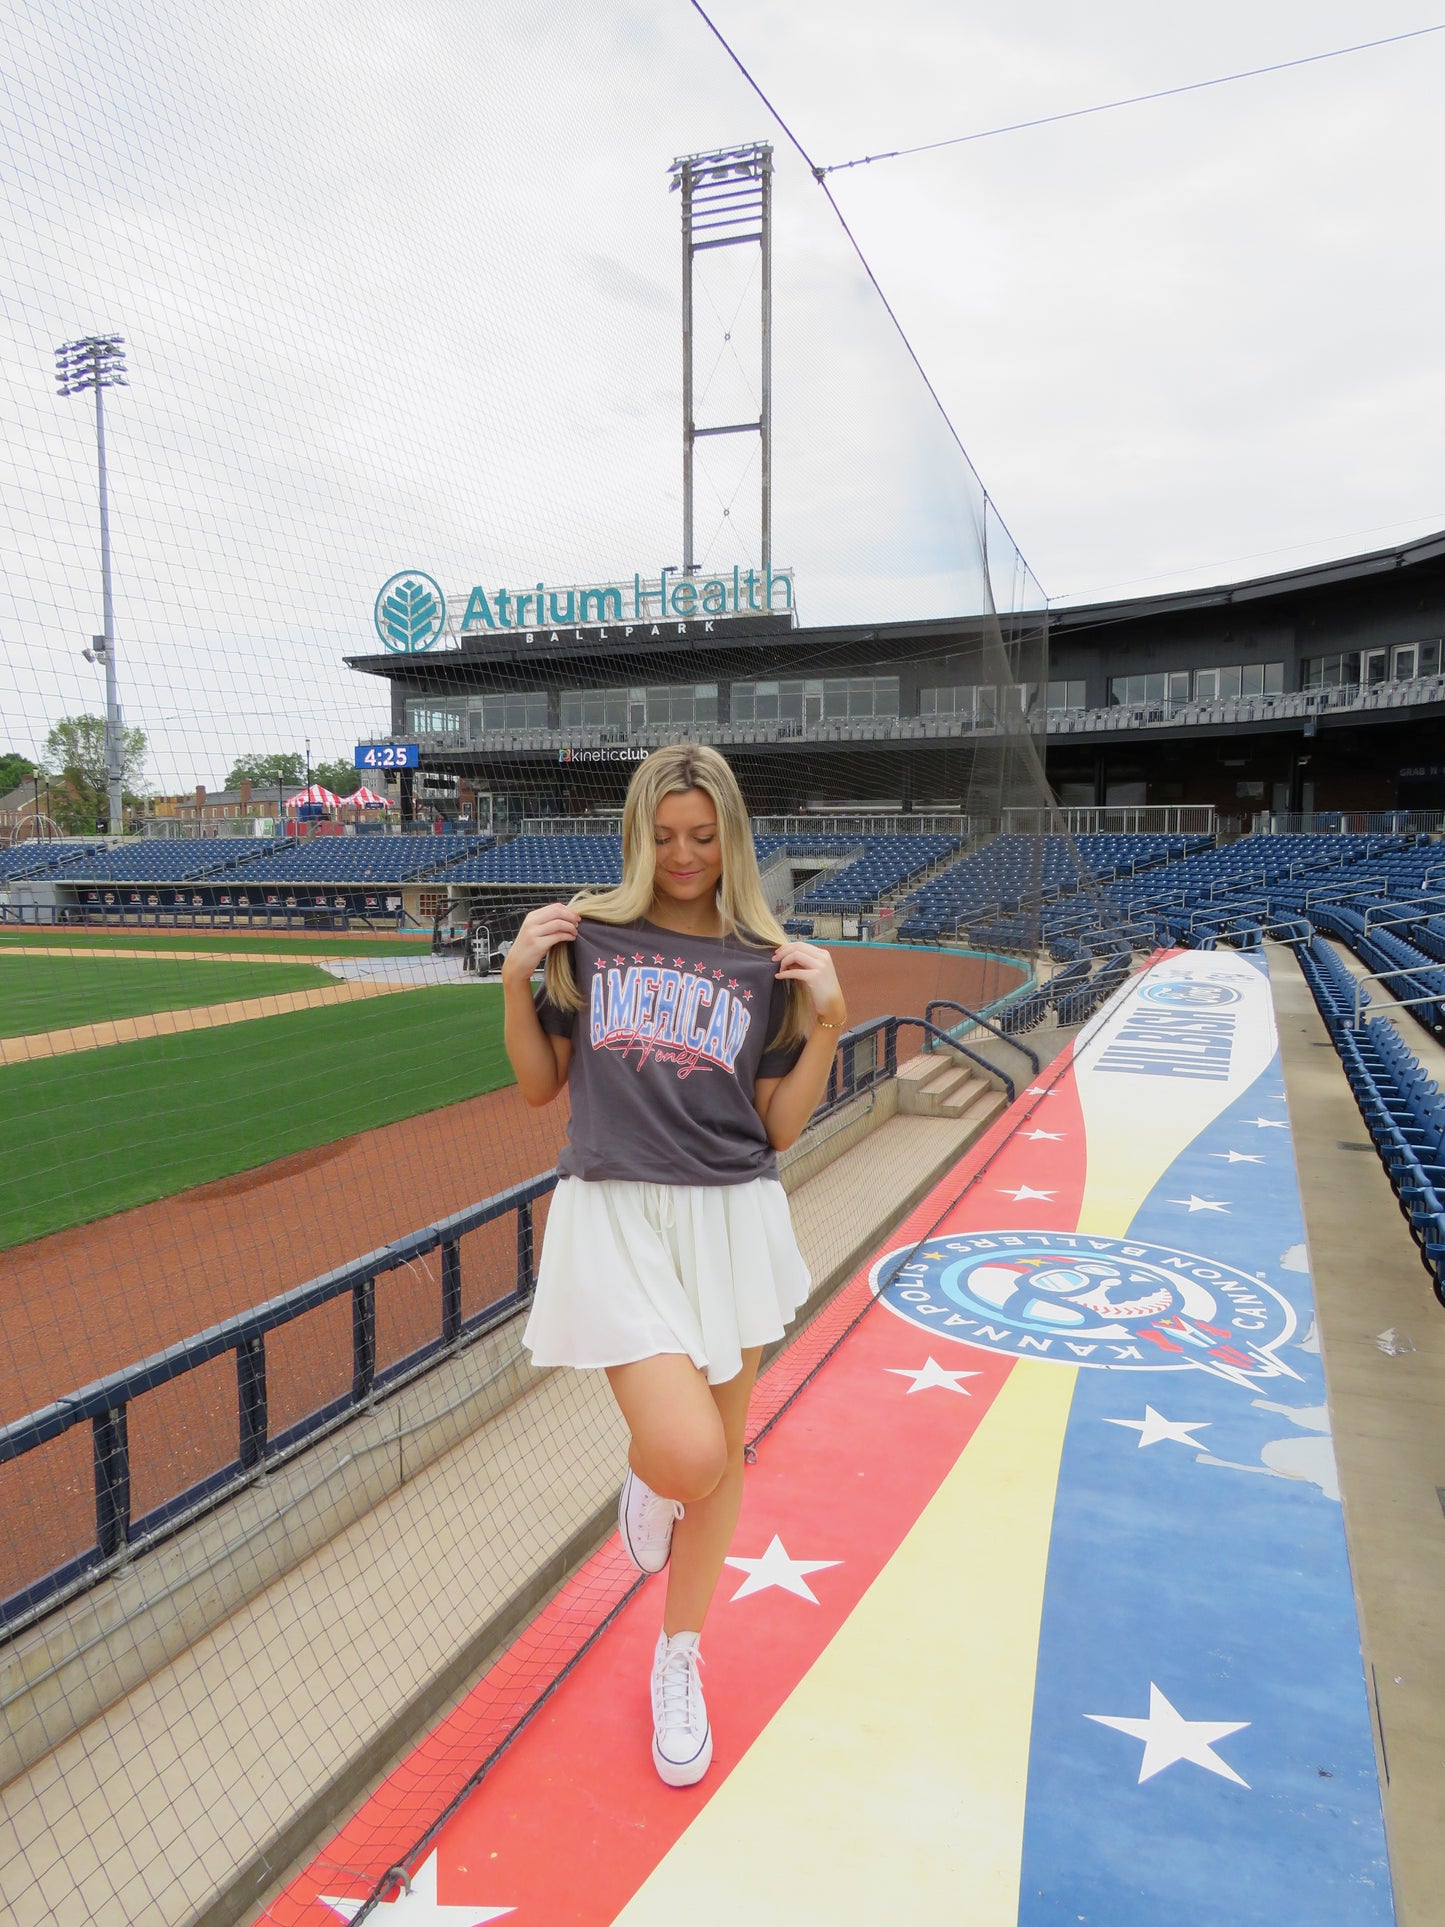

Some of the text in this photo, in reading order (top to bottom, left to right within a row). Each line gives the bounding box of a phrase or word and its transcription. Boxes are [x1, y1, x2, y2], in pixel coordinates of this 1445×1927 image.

[461, 562, 791, 631] Atrium Health
[526, 621, 714, 643] BALLPARK
[364, 748, 407, 766] 4:25
[590, 967, 751, 1074] AMERICAN
[604, 1021, 713, 1080] Honey
[1093, 1007, 1236, 1082] HILBISH
[895, 1263, 1145, 1360] KANNAPOLIS
[945, 1236, 1268, 1330] CANNON BALLERS
